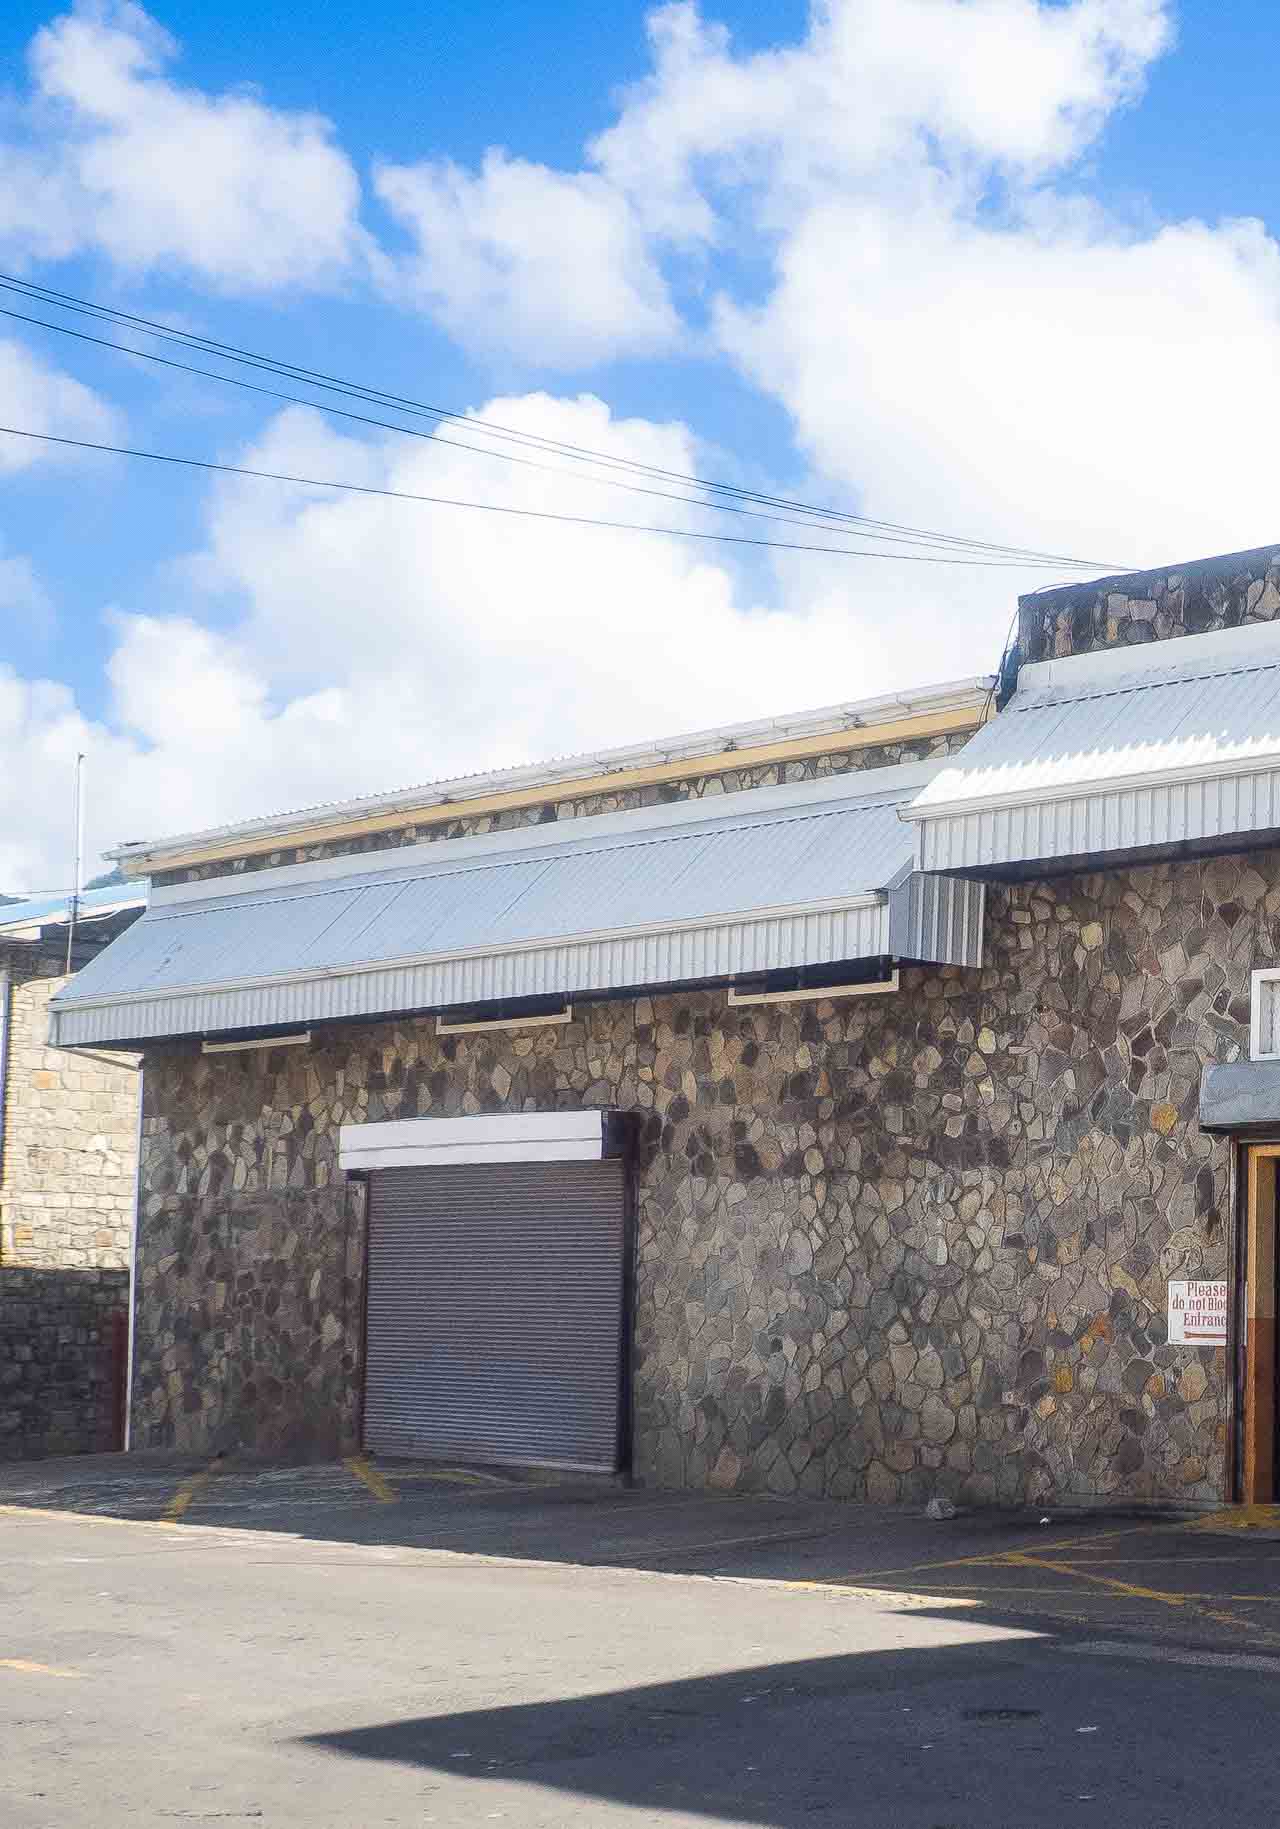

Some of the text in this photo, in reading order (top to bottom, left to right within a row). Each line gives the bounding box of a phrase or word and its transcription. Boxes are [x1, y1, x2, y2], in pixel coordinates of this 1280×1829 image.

[1187, 1281, 1227, 1297] Please
[1172, 1294, 1227, 1311] do not Blo
[1183, 1312, 1227, 1327] Entranc
